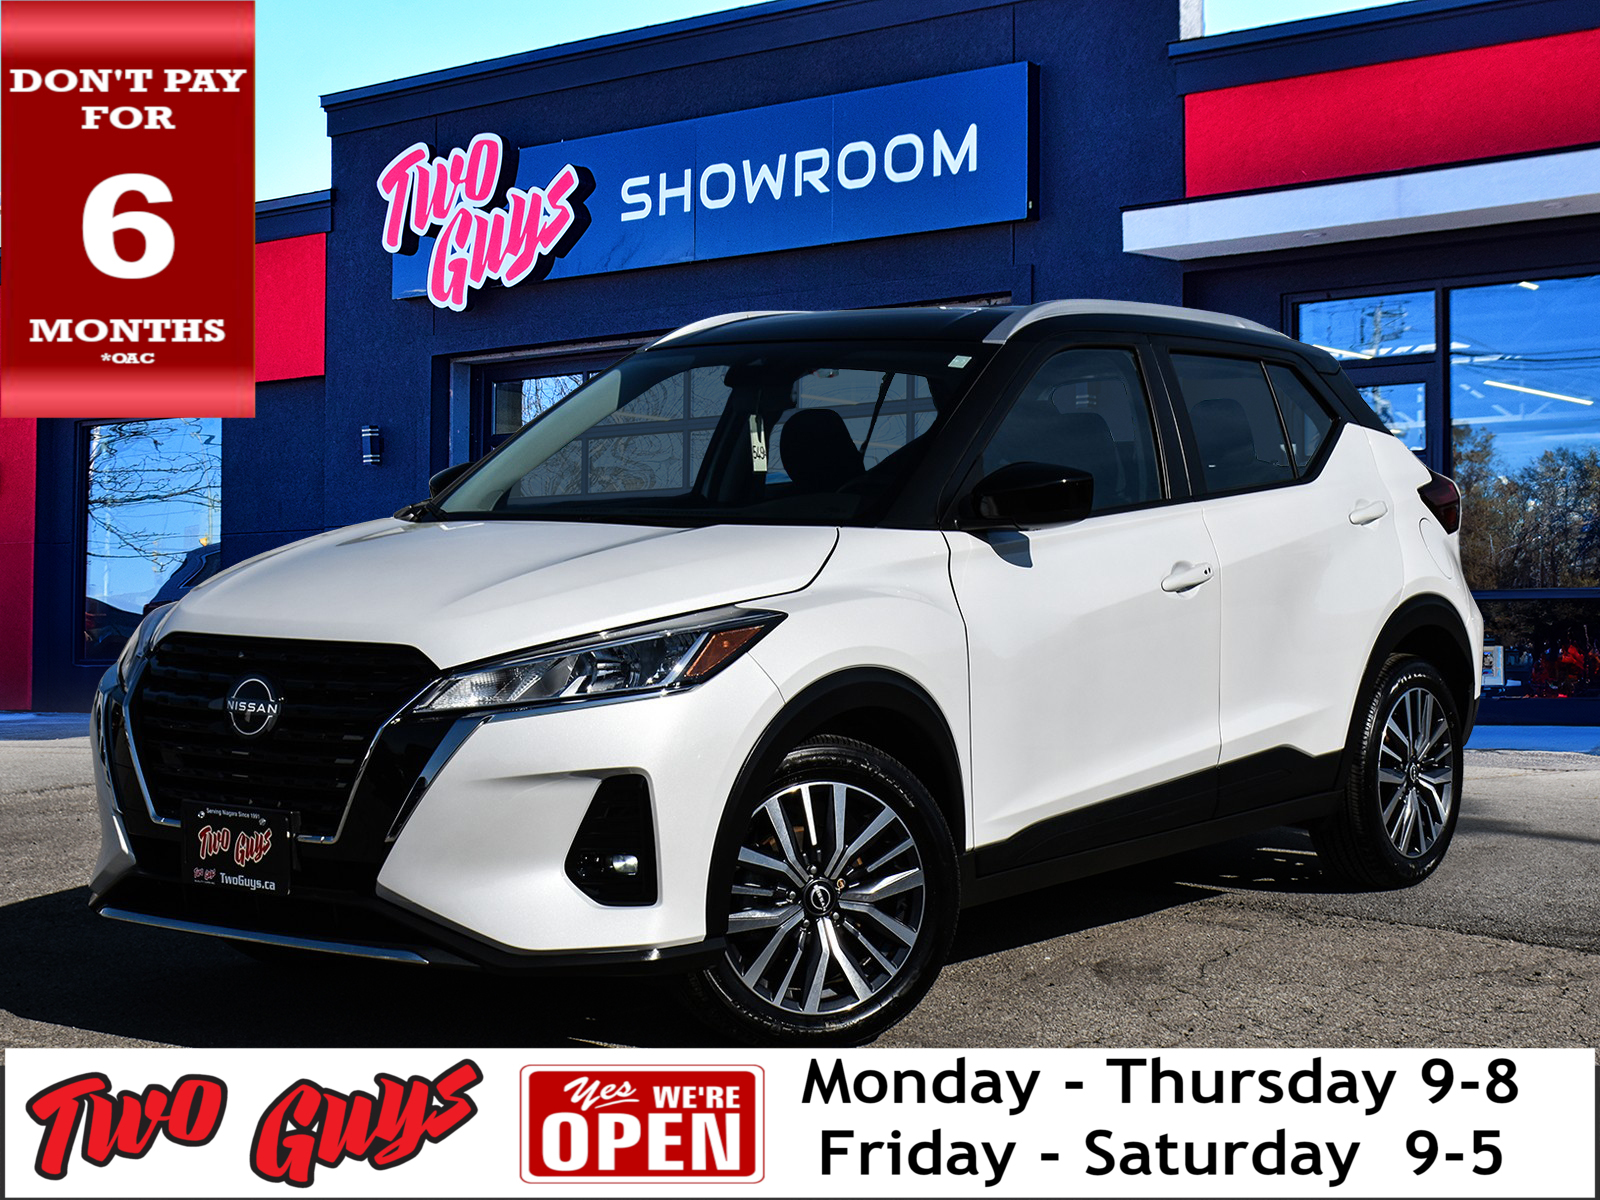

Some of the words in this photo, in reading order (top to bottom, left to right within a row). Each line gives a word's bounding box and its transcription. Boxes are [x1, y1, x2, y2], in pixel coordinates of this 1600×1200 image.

[620, 123, 977, 222] SHOWROOM
[427, 163, 580, 312] Guys
[226, 700, 278, 714] NISSAN
[234, 827, 273, 868] Guys
[219, 872, 276, 891] TwoGuys.ca
